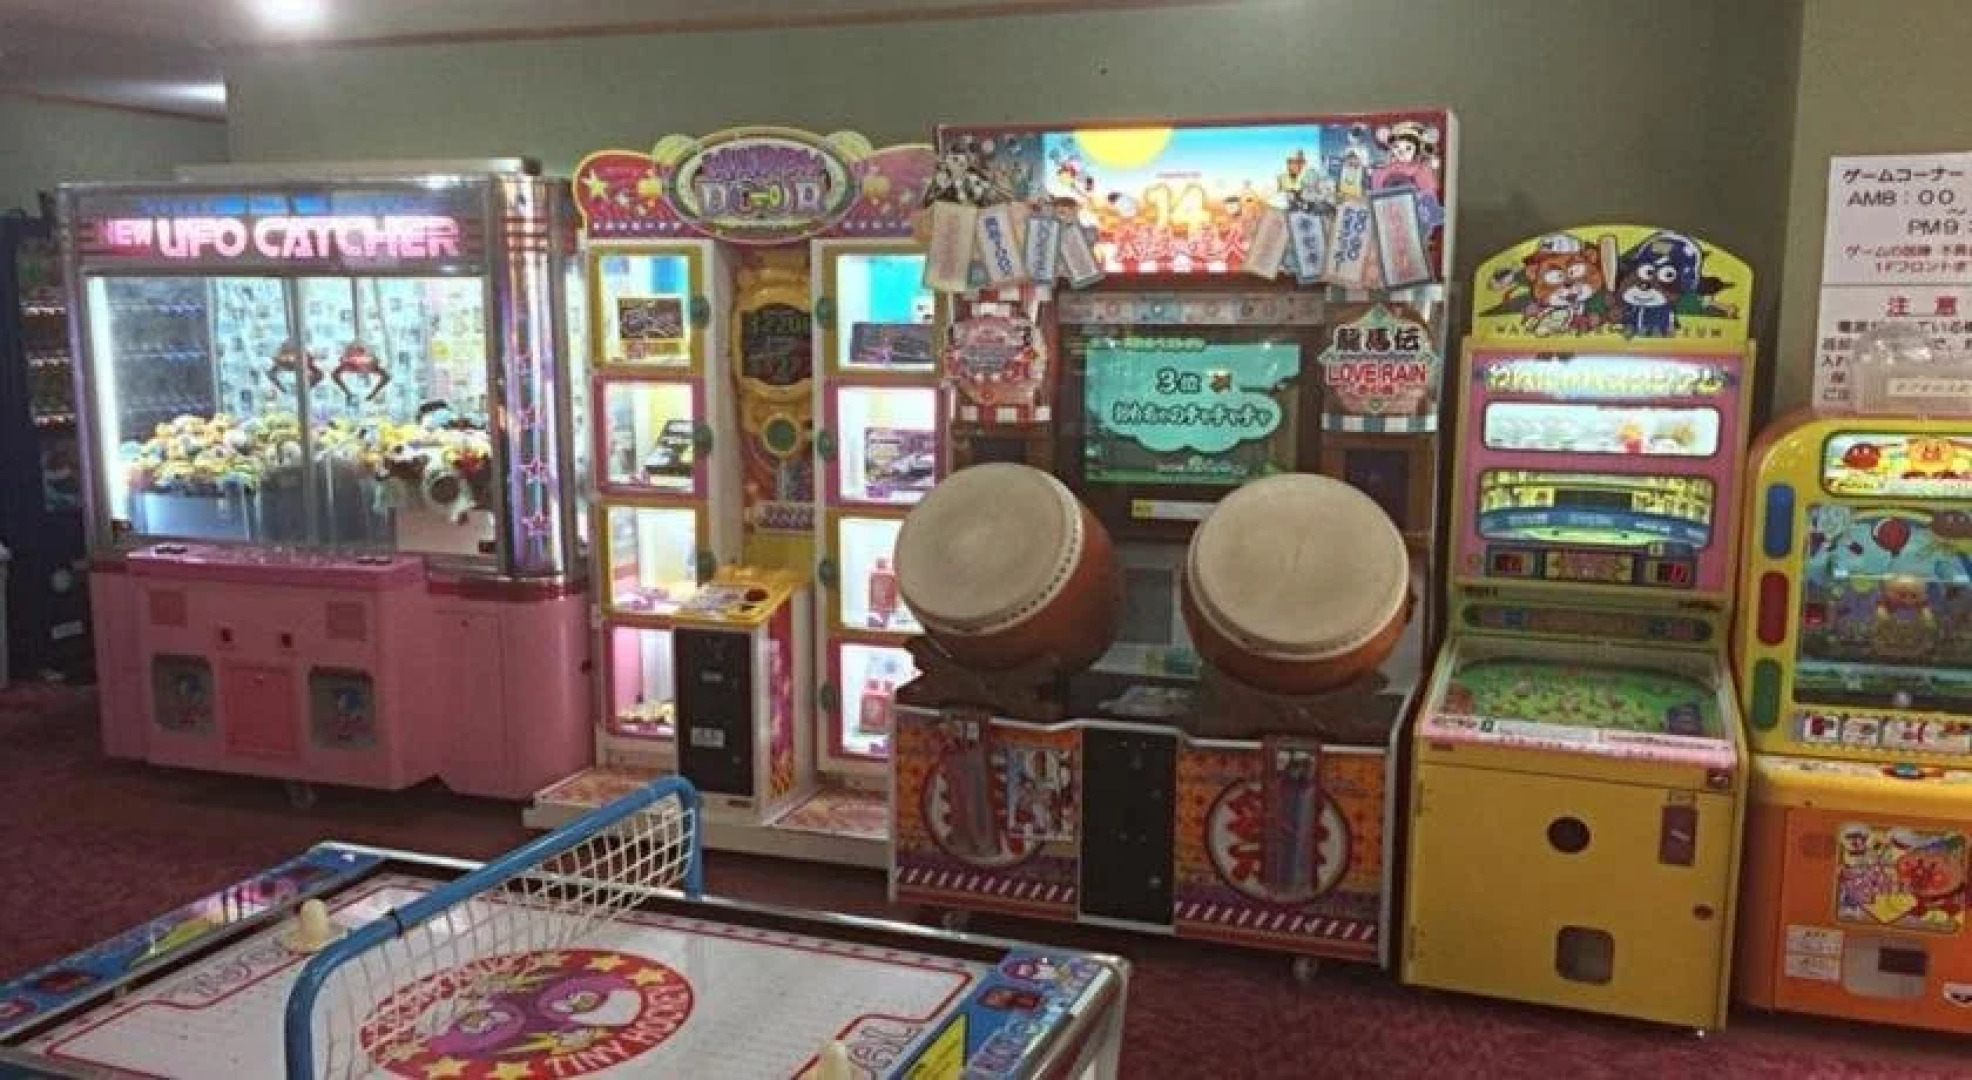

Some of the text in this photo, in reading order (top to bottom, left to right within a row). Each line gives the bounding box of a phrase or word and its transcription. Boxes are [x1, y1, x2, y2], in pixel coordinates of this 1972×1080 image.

[1842, 166, 1964, 184] ゲームコーナー
[1144, 182, 1212, 241] 14
[154, 216, 247, 258] UFO
[253, 214, 460, 259] CATCHER
[1326, 363, 1427, 385] LOVE RAIN
[546, 1036, 629, 1078] TINY
